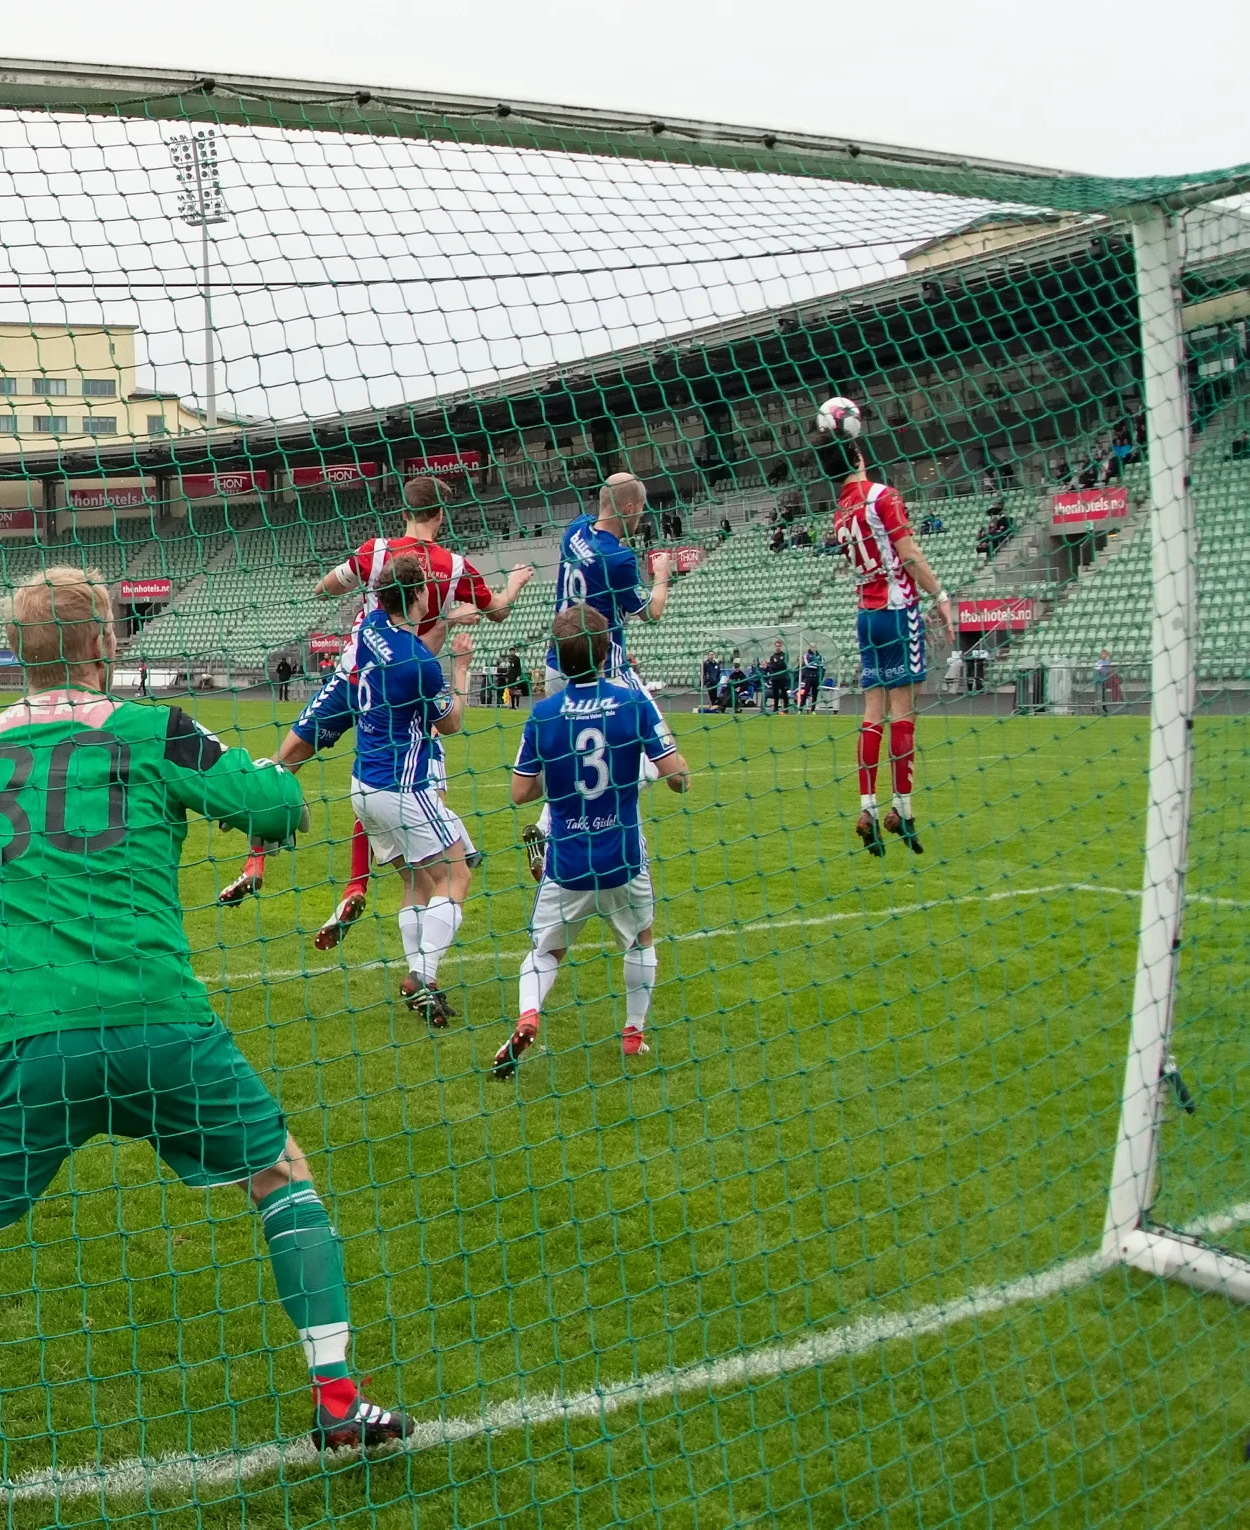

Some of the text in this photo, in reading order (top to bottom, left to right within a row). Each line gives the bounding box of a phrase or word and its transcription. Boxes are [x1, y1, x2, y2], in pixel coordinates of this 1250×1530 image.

[325, 471, 352, 480] HON
[960, 608, 1032, 623] thonhotels.no
[574, 727, 609, 801] 3
